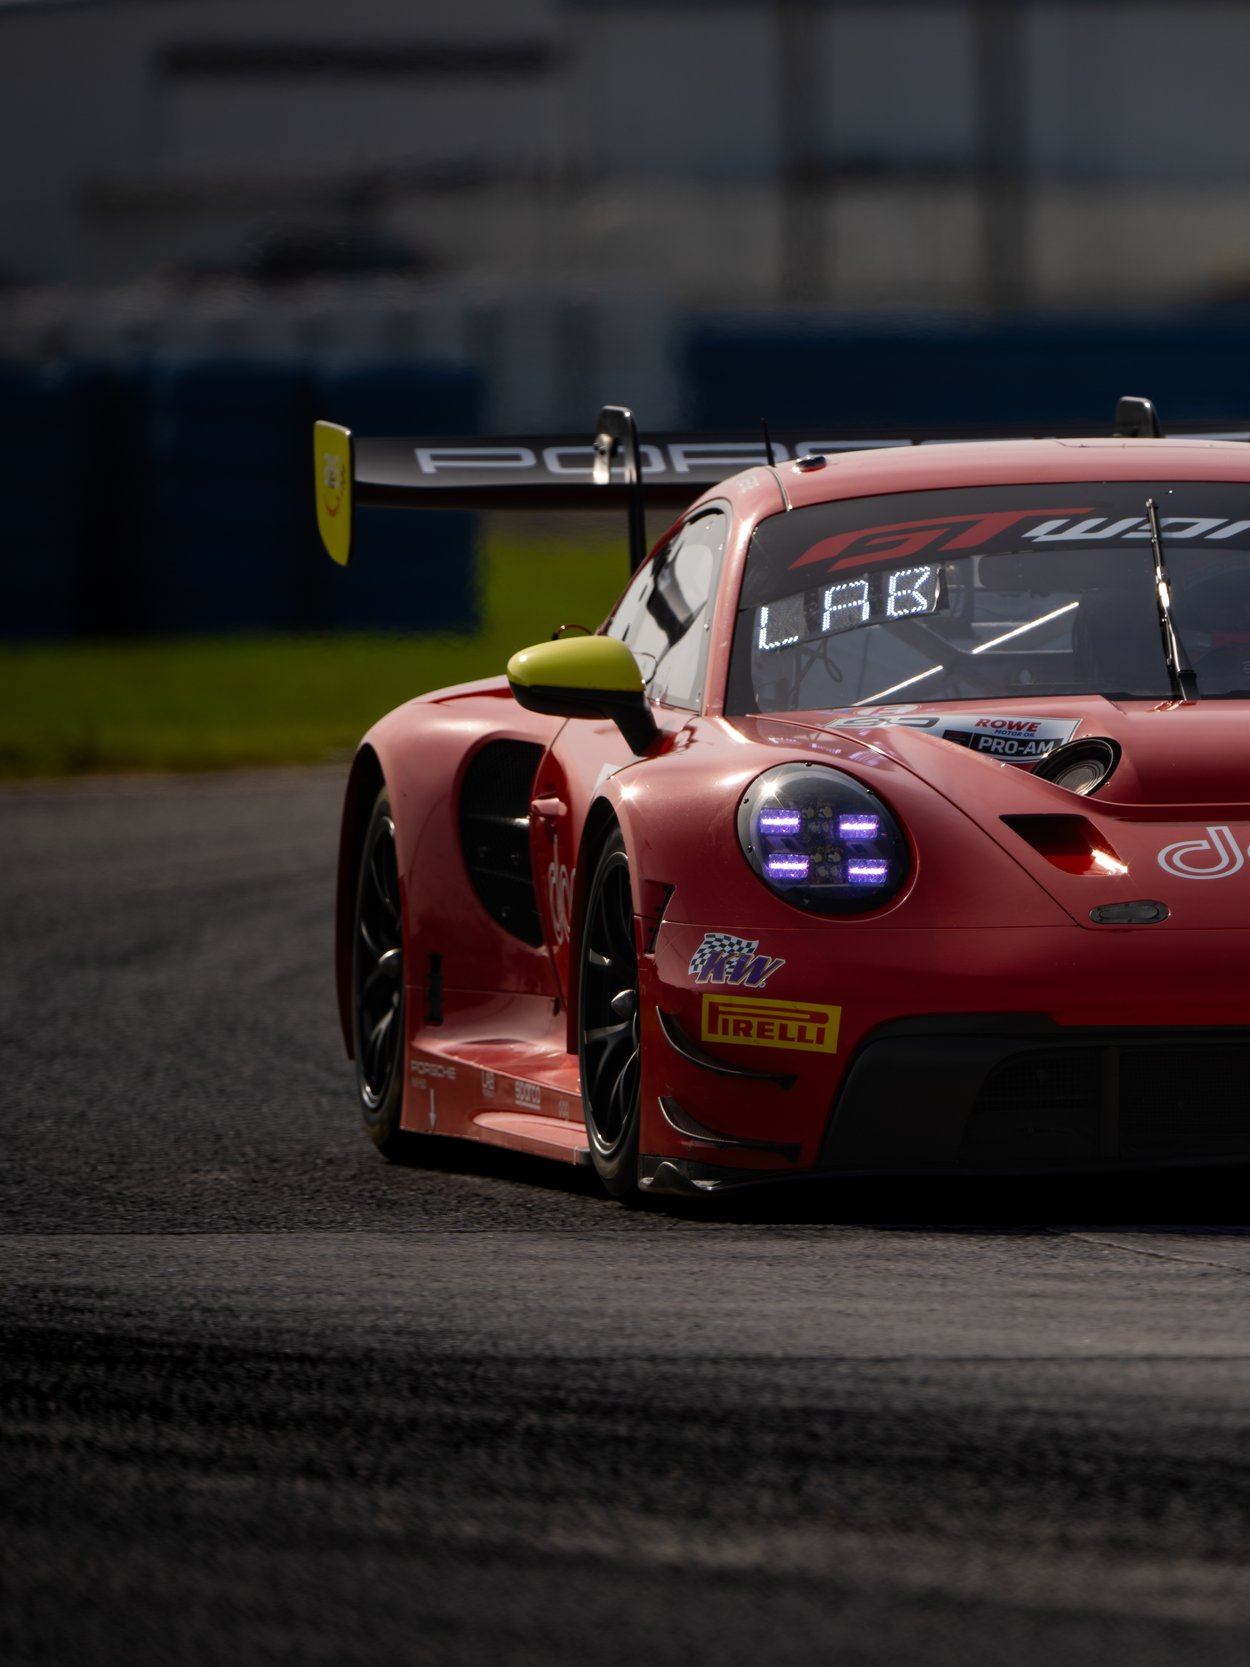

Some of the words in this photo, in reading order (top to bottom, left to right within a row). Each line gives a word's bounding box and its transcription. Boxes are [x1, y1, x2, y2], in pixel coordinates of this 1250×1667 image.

[788, 507, 1095, 573] GT
[758, 565, 931, 651] LAB
[975, 718, 1041, 732] ROWE
[994, 729, 1022, 738] MOTOR
[978, 737, 1055, 756] PRO-AM
[696, 950, 786, 988] KW
[708, 1002, 829, 1045] PIRELLI
